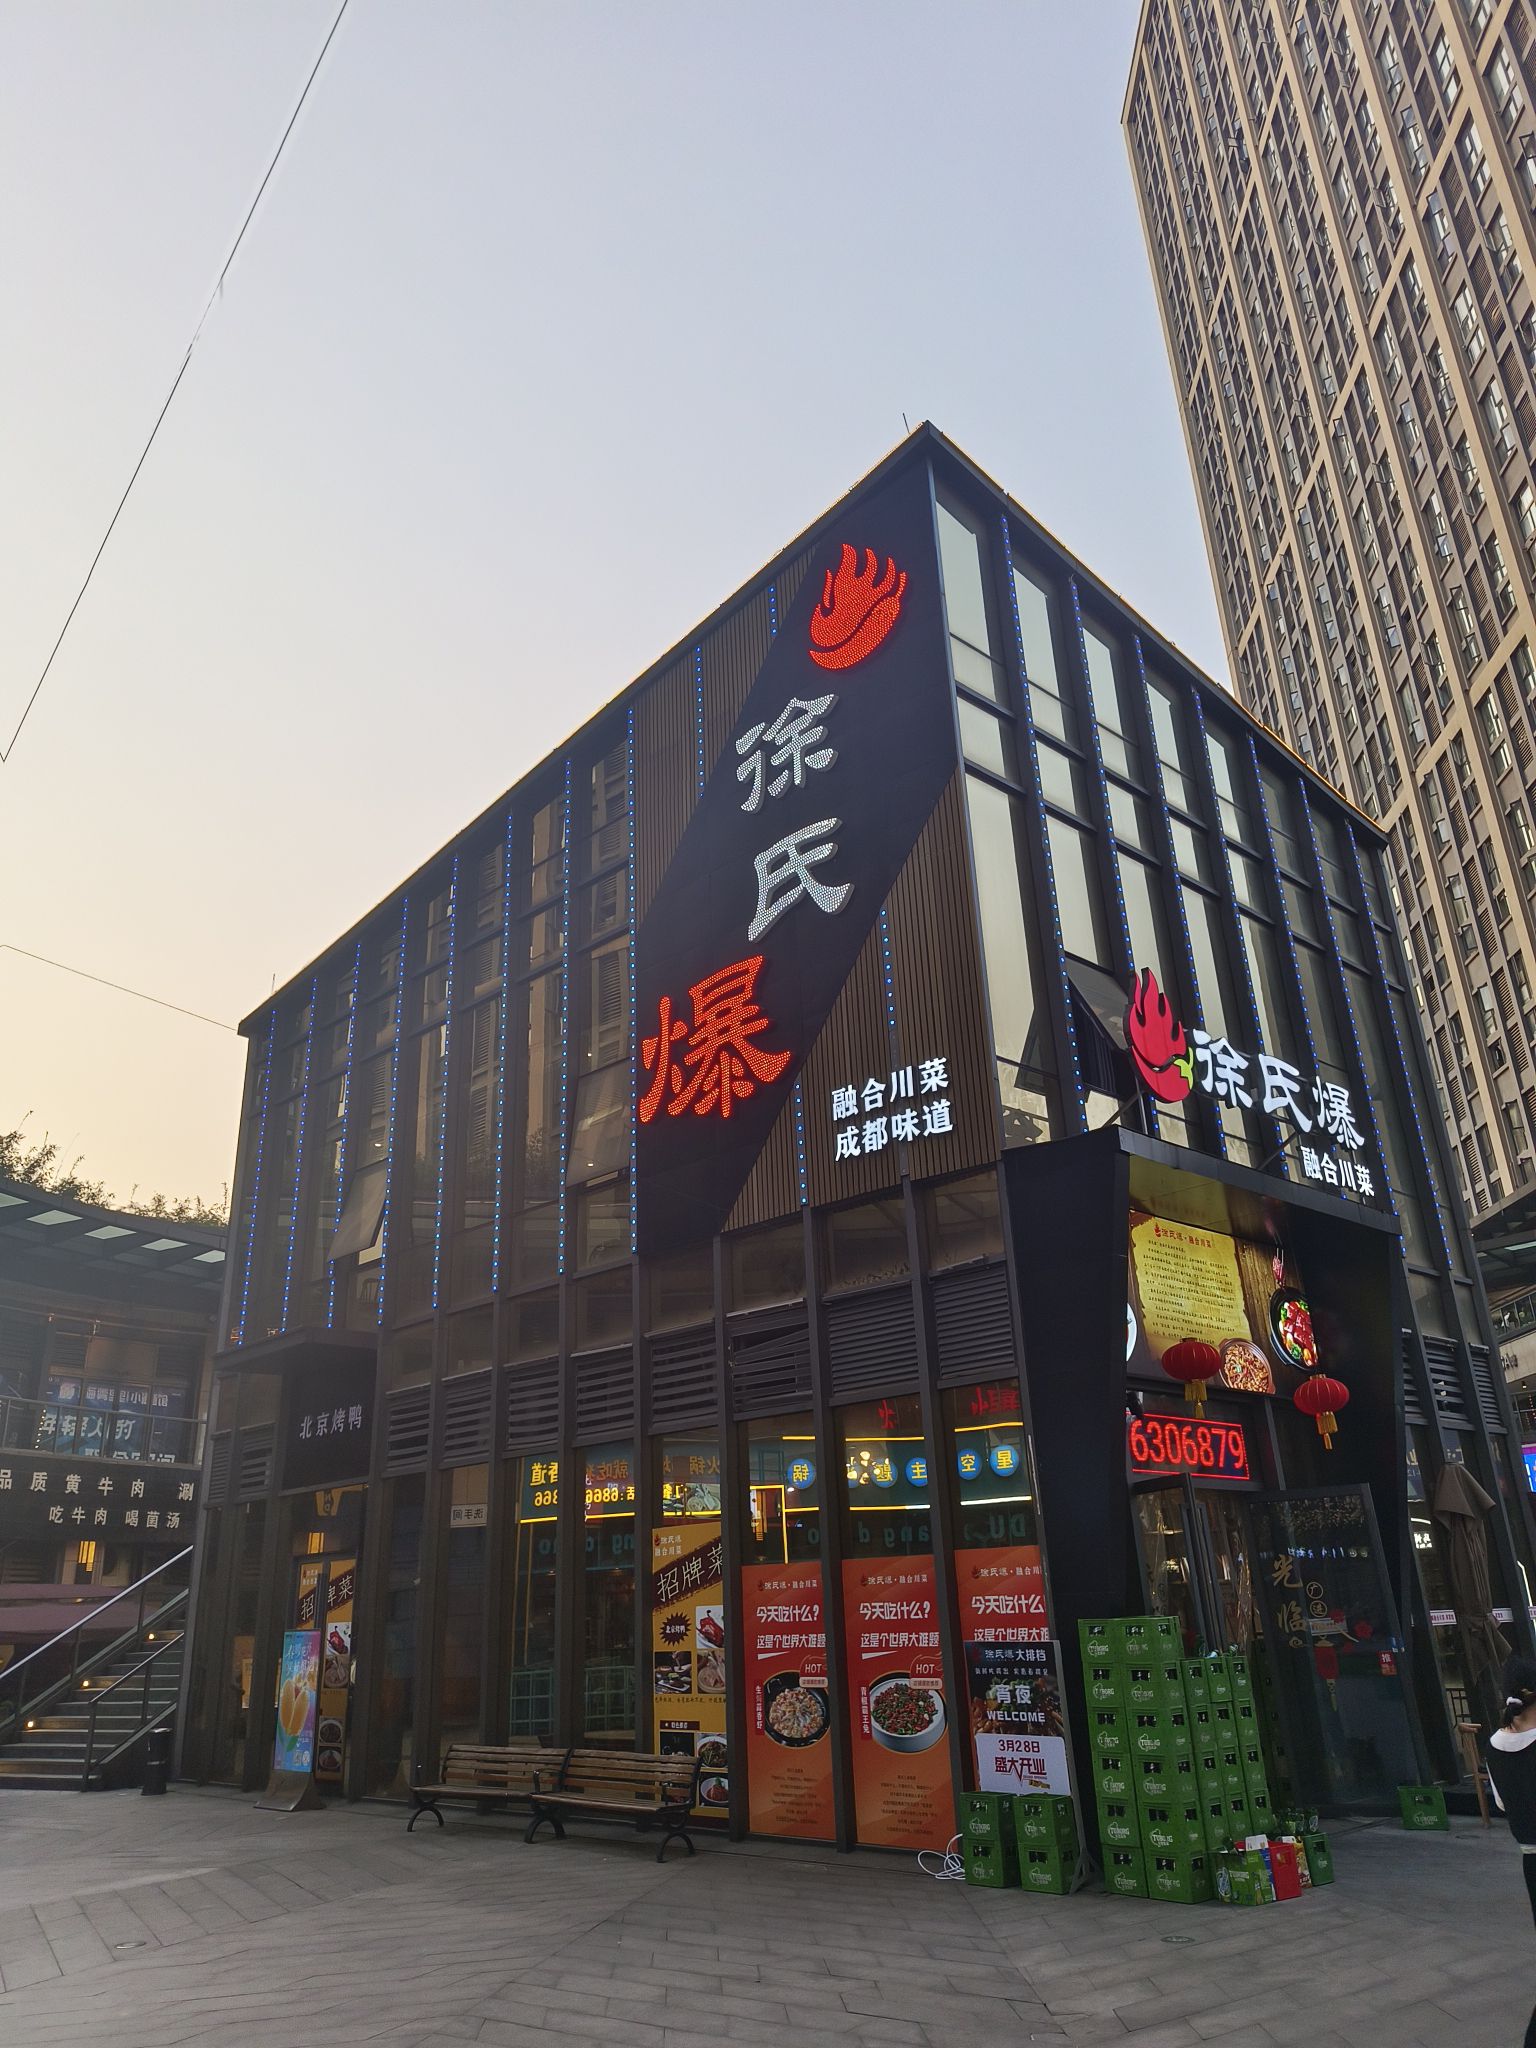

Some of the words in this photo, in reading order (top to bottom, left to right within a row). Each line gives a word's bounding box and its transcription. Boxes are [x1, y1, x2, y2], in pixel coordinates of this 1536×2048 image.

[639, 692, 855, 1124] 徐氏爆
[831, 1057, 949, 1120] 融合川菜
[1193, 1029, 1365, 1150] 徐氏爆
[835, 1099, 953, 1161] 成都味道
[1300, 1145, 1375, 1197] 融合川菜
[299, 1403, 362, 1439] 北京烤鸭
[1131, 1419, 1244, 1469] 6306879
[0, 1469, 145, 1498] 品质黄牛肉
[176, 1482, 195, 1502] 涮
[49, 1505, 109, 1527] 吃牛肉
[125, 1509, 182, 1529] 喝菌汤
[657, 1542, 723, 1602] 招牌菜
[756, 1604, 820, 1623] 今天吃什么?
[859, 1600, 931, 1621] 今天吃什么?
[971, 1594, 1046, 1615] 今天吃什么
[756, 1633, 826, 1649] 这是个世界大难题
[860, 1631, 940, 1648] 这是个世界大难题
[805, 1663, 823, 1674] HOT
[915, 1663, 935, 1675] HOT
[996, 1683, 1032, 1705] 宵夜
[987, 1709, 1046, 1723] WELCOME
[998, 1739, 1040, 1753] 3月28日
[995, 1756, 1047, 1784] 盛大开业
